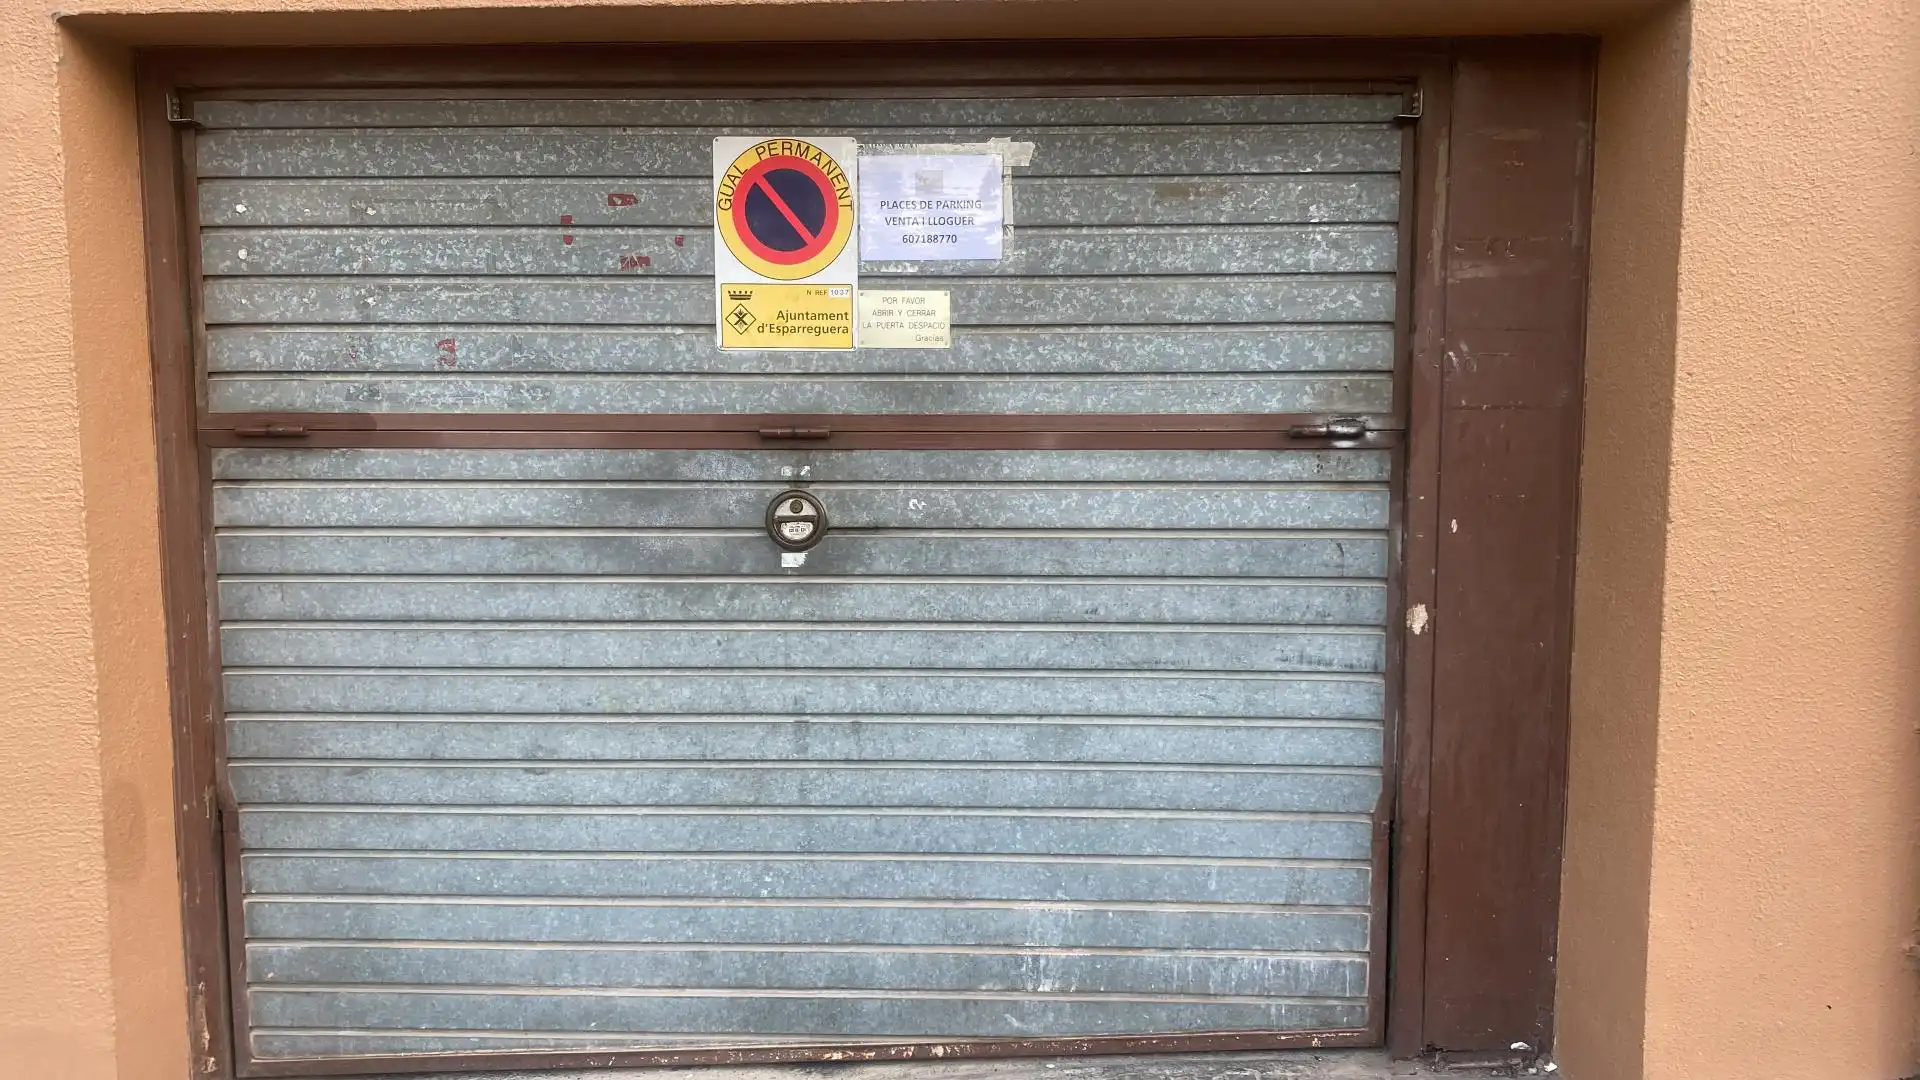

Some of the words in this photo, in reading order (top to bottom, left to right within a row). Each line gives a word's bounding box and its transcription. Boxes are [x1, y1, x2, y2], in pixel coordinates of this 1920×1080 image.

[718, 164, 748, 211] GUAL
[755, 141, 853, 211] PERMANENT
[880, 200, 917, 210] PLACES
[920, 200, 933, 210] DE
[936, 200, 982, 209] PARKING
[885, 216, 919, 226] VENTA
[928, 216, 975, 226] LLOGUER
[902, 234, 957, 244] 607188770
[882, 296, 898, 305] POR
[901, 296, 926, 305] FAVOR
[776, 309, 849, 323] Ajuntament
[872, 309, 894, 317] ABRIR
[897, 309, 903, 317] Y
[906, 309, 936, 317] CERRAR
[757, 323, 849, 337] d'Esparreguera
[876, 322, 904, 330] PUERTA
[908, 322, 946, 330] DESPACIO
[915, 334, 944, 342] Gracias
